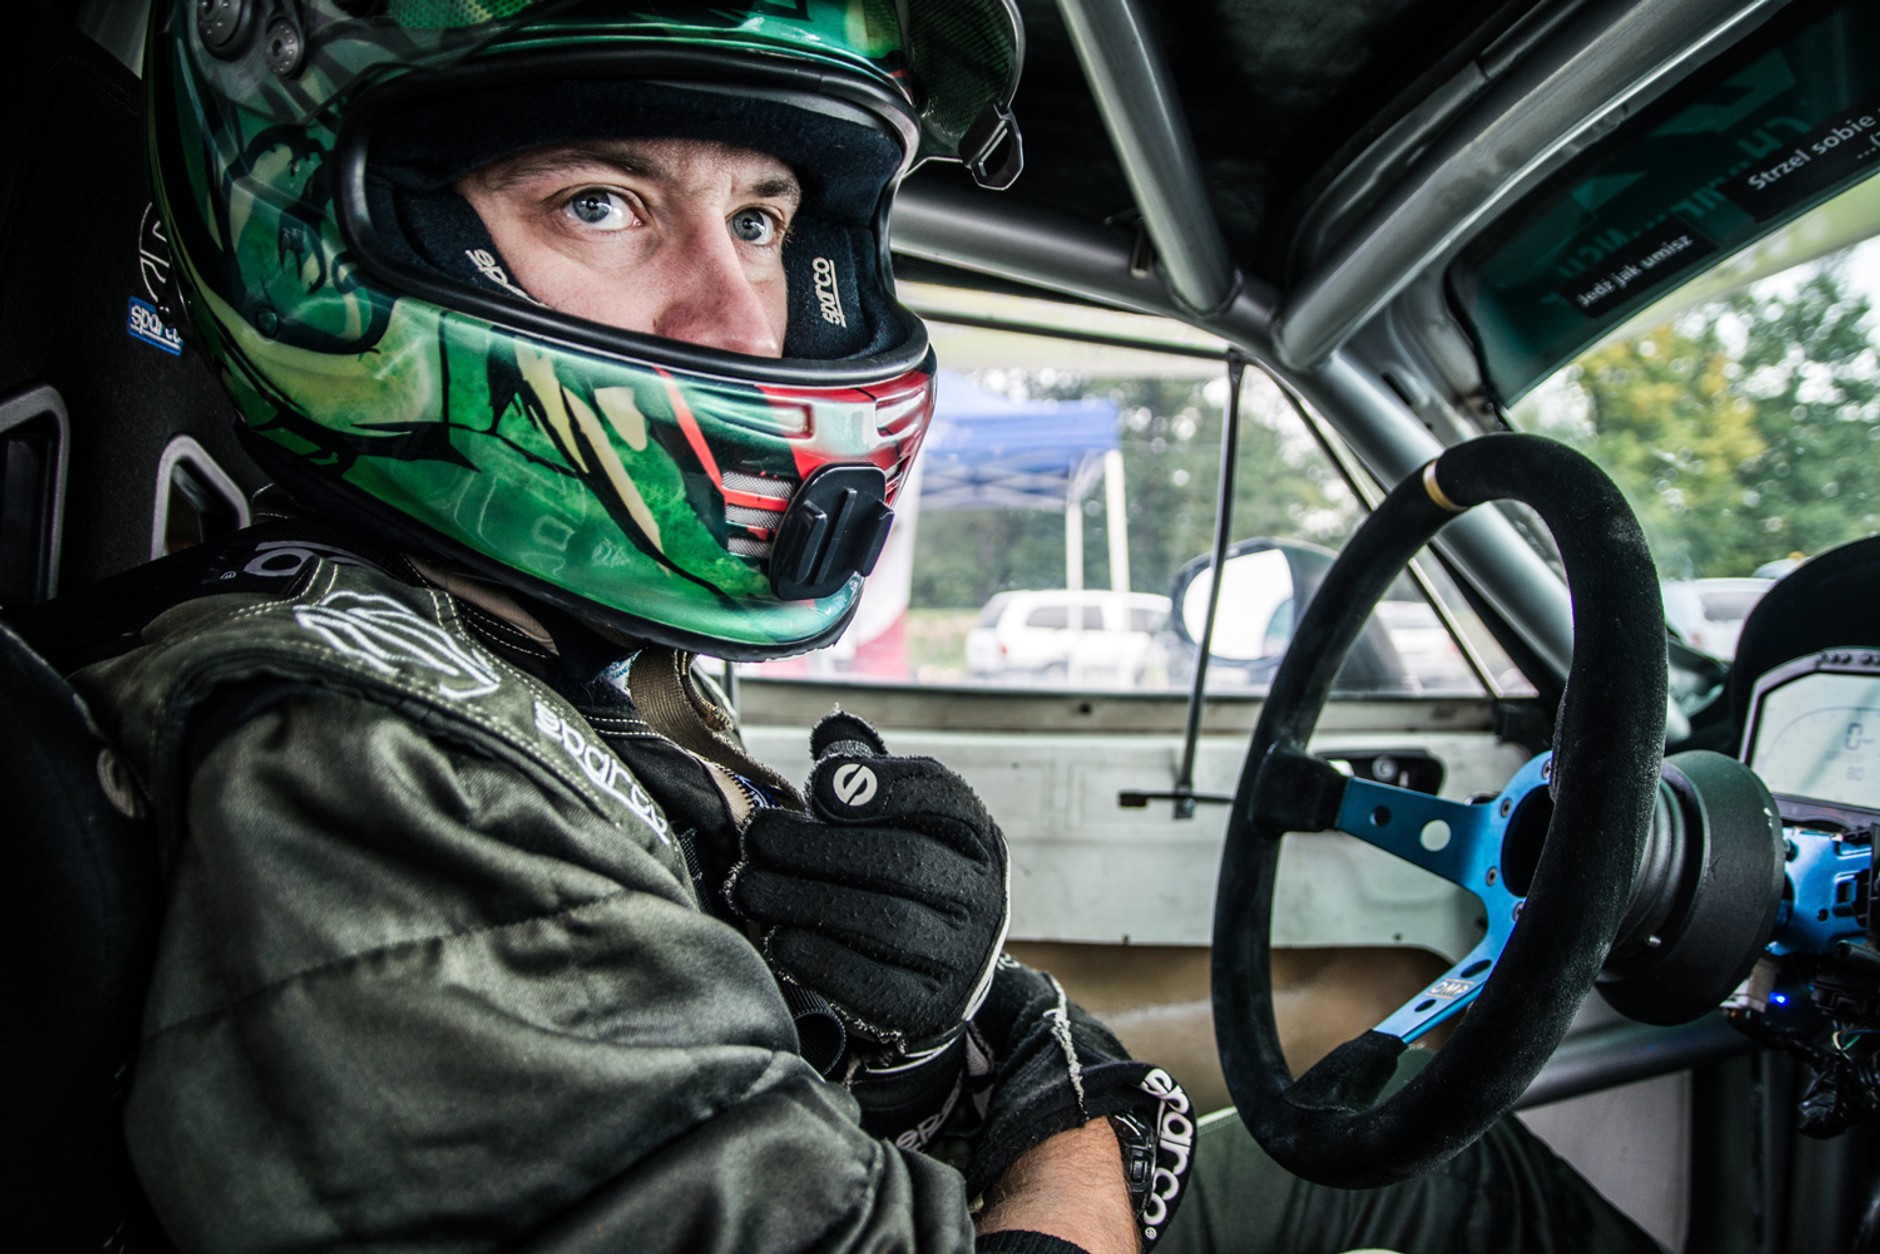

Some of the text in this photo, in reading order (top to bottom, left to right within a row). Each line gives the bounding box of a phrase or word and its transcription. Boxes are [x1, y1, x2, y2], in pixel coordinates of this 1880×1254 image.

[1747, 149, 1812, 191] Strzel
[1811, 115, 1877, 155] sobie
[812, 256, 844, 326] sparco
[1611, 264, 1642, 289] jak
[534, 701, 668, 844] sparco
[1430, 981, 1470, 996] OMP
